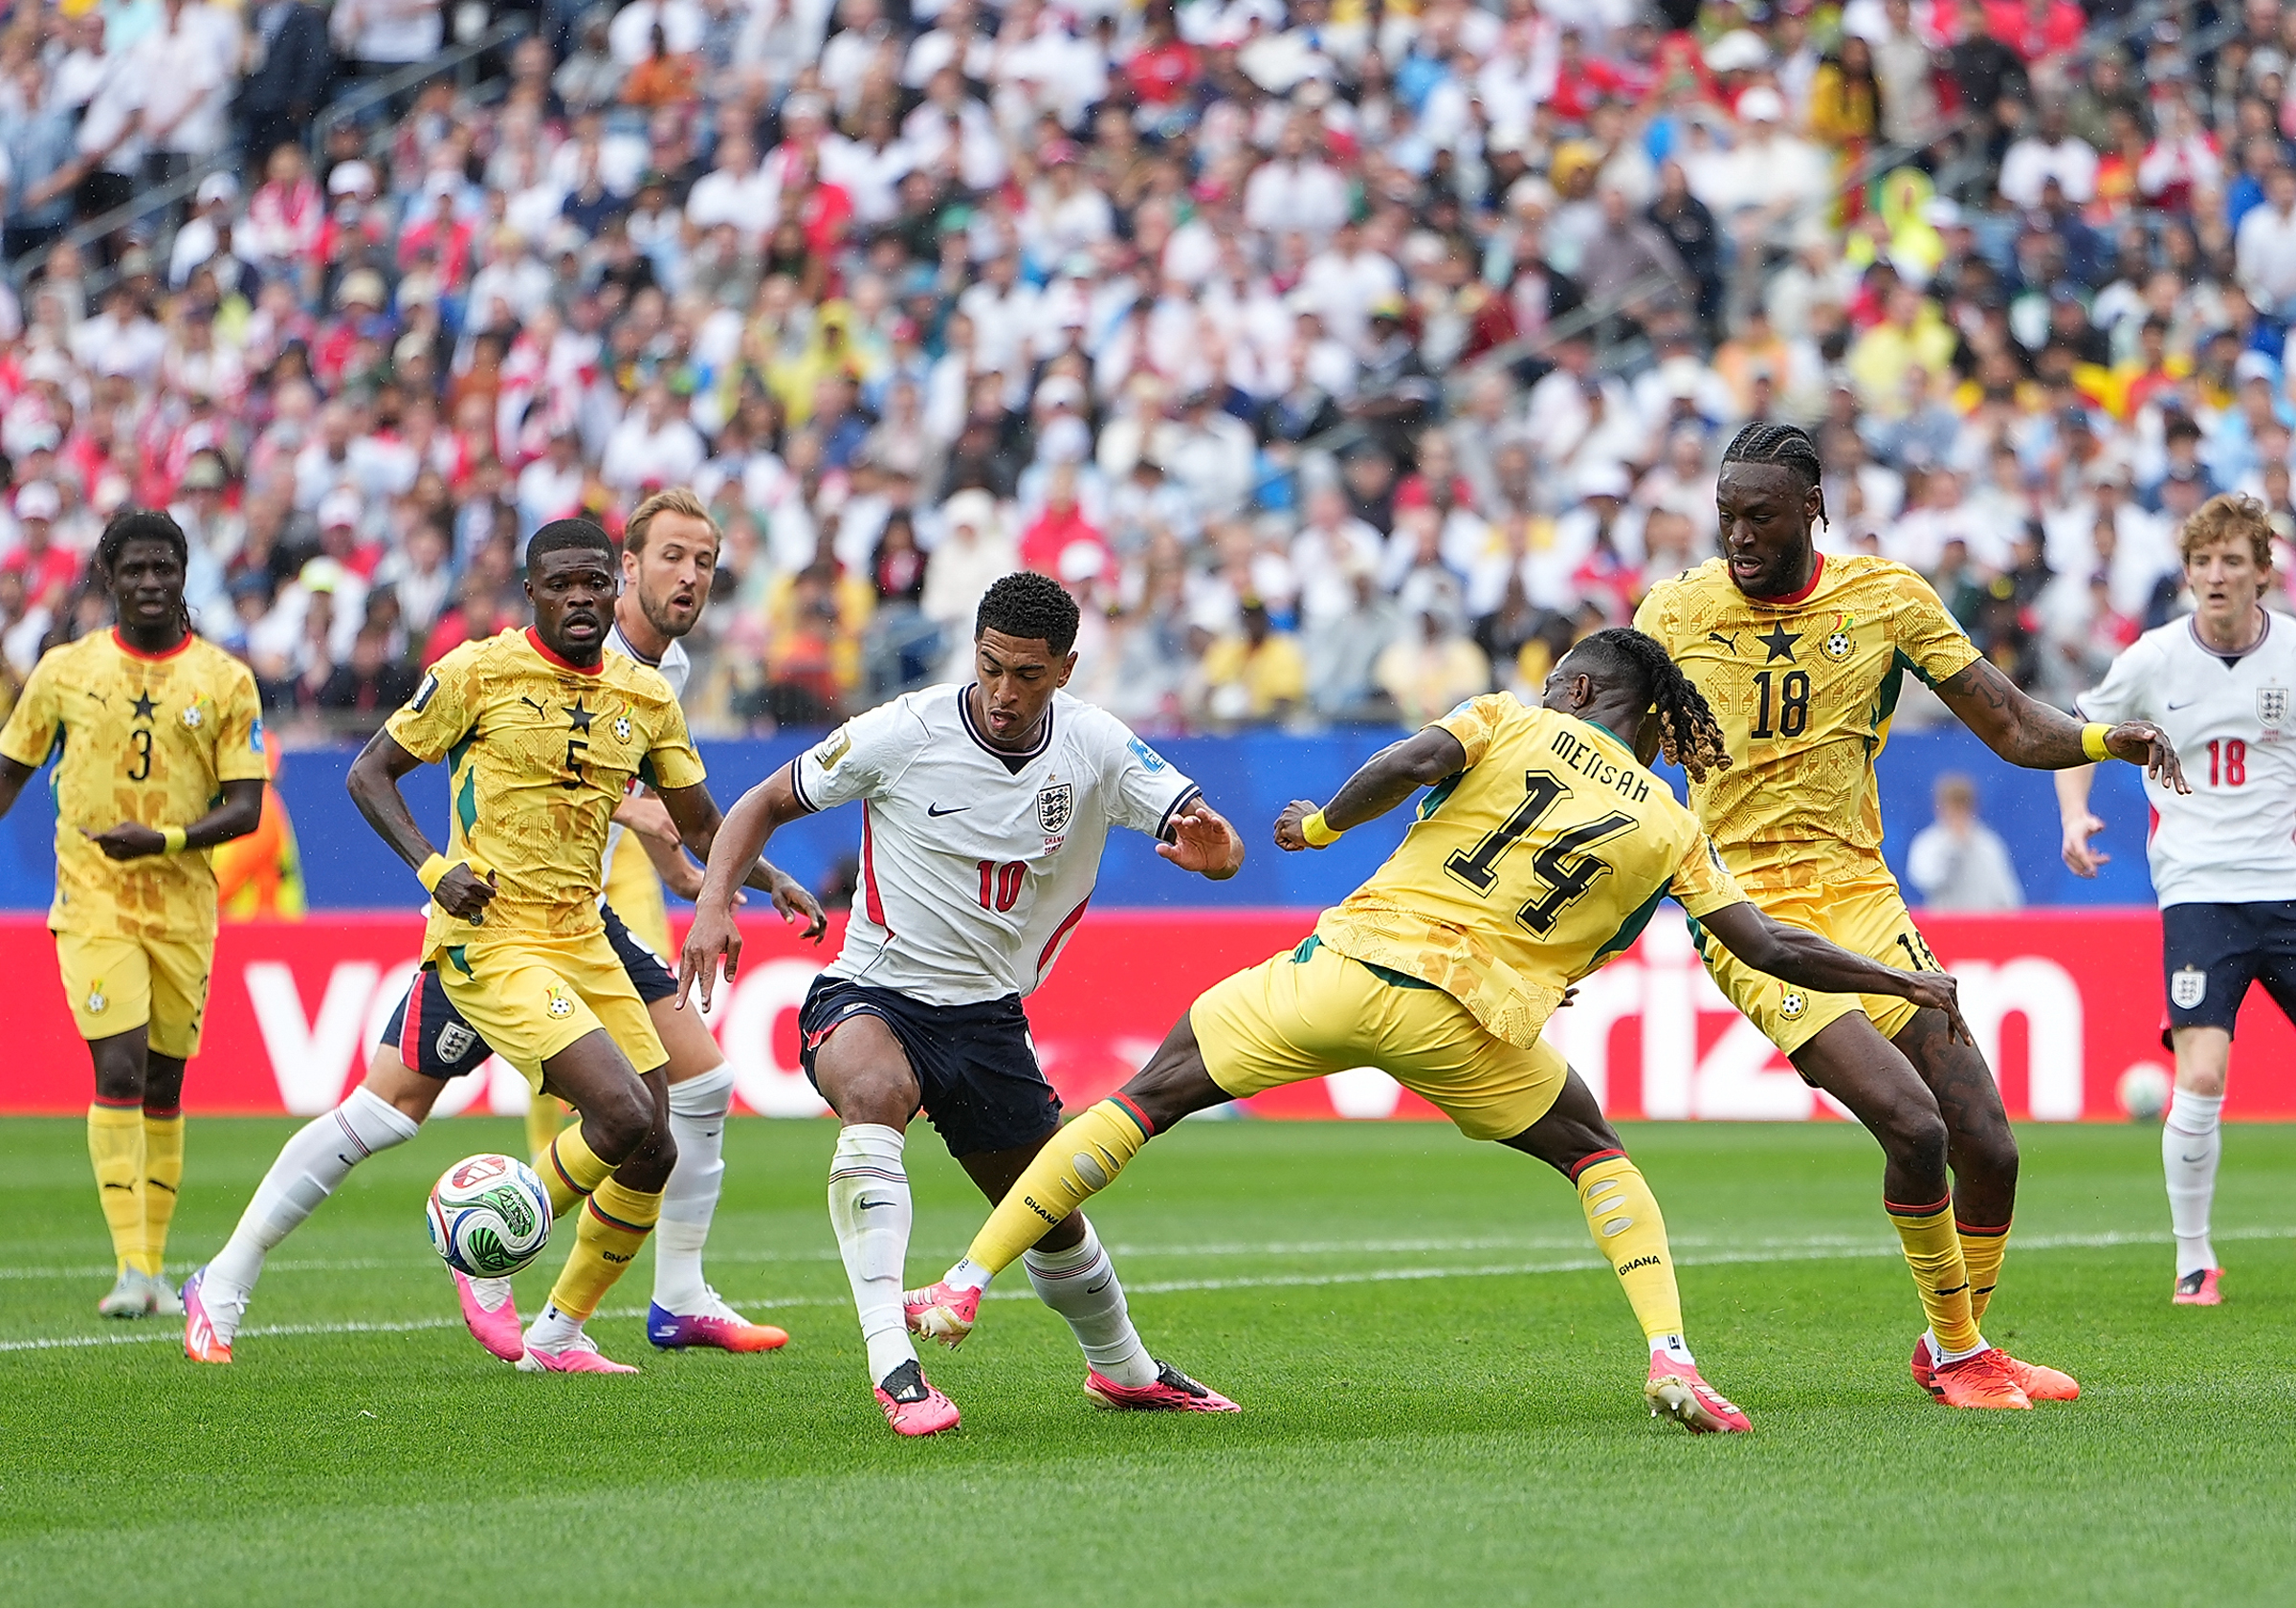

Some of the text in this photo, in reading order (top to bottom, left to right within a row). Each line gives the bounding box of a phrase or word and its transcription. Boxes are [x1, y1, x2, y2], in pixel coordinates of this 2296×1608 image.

[1751, 670, 1811, 739] 18
[127, 729, 152, 781] 3
[560, 739, 589, 791] 5
[1550, 731, 1649, 804] MENSAH
[2205, 739, 2246, 787] 18
[1444, 769, 1640, 942] 14
[976, 859, 1028, 913] 10
[1618, 1255, 1662, 1276] GHANA
